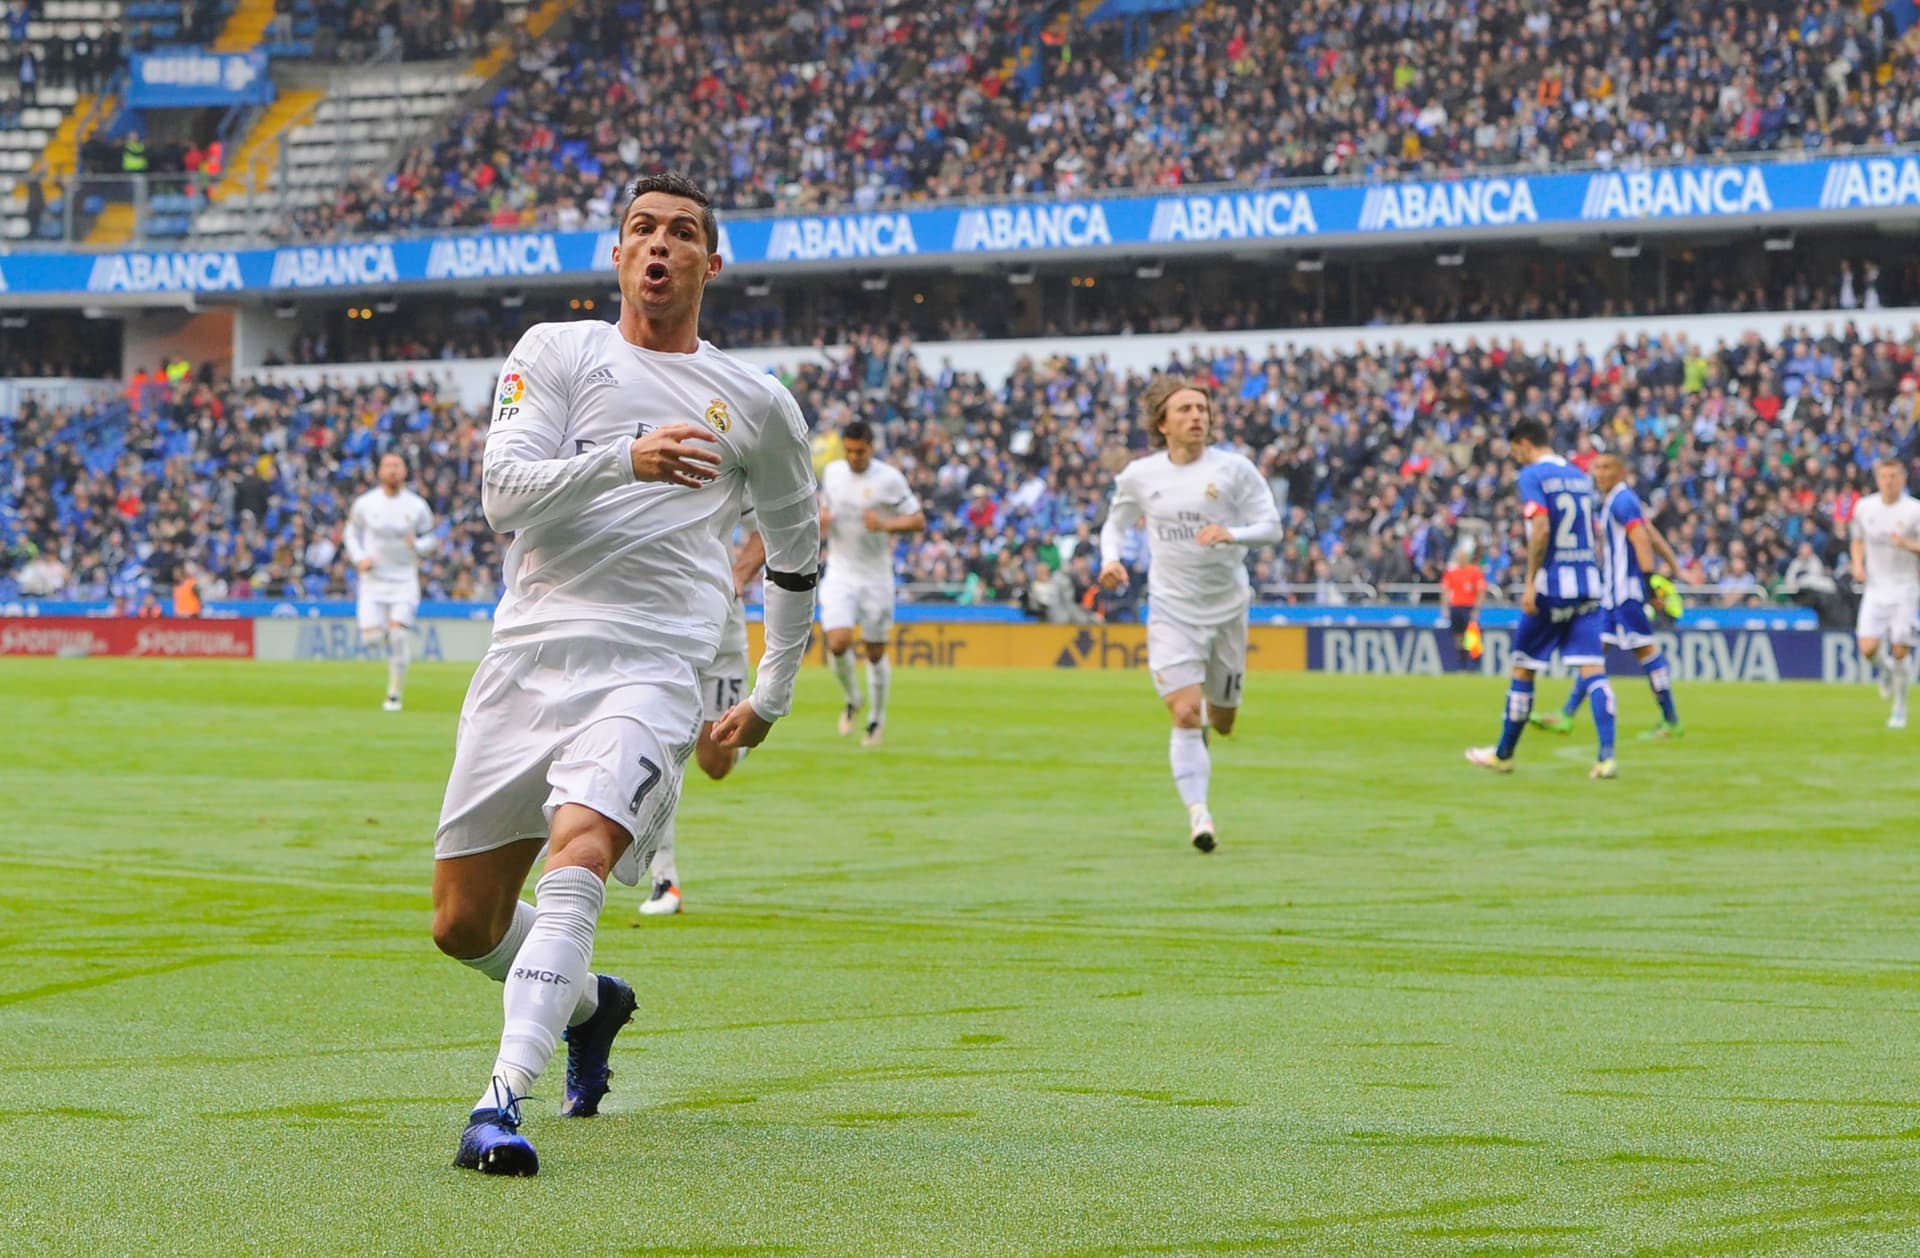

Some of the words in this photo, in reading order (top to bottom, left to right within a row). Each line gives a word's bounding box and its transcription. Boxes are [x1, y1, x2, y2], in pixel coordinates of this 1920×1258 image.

[1168, 192, 1318, 240] ABANCA
[1375, 179, 1538, 230] ABANCA
[1604, 167, 1772, 219] ABANCA
[781, 215, 917, 260] ABANCA
[970, 203, 1111, 250] ABANCA
[107, 252, 243, 291] ABANCA
[281, 244, 399, 287] ABANCA
[442, 235, 561, 277] ABANCA
[494, 407, 520, 422] FP
[1555, 493, 1594, 549] 21
[1322, 629, 1445, 675] BBVA
[629, 755, 662, 815] 7
[514, 967, 571, 985] RMCF
